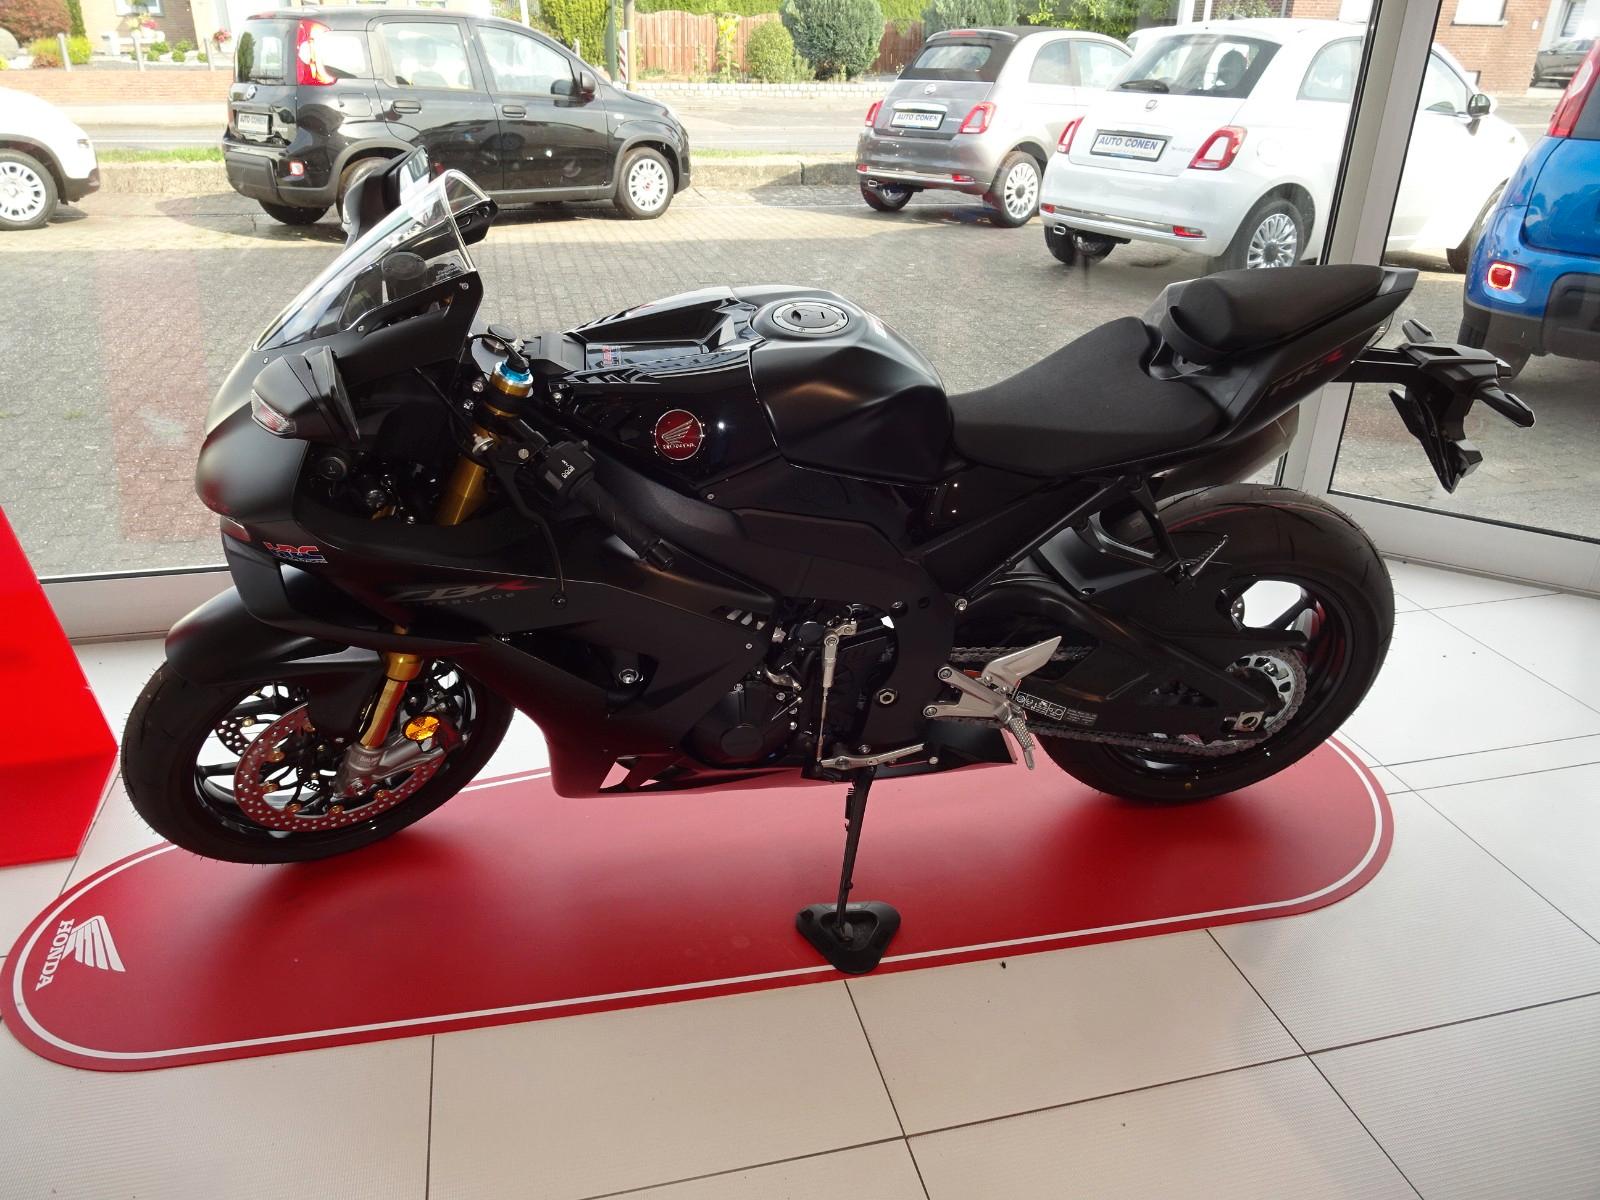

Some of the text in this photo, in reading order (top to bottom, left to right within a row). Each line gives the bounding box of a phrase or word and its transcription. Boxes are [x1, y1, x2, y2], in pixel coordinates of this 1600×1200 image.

[1099, 136, 1123, 146] AUTO
[1125, 138, 1158, 150] CONEN
[35, 918, 76, 992] HONDA
